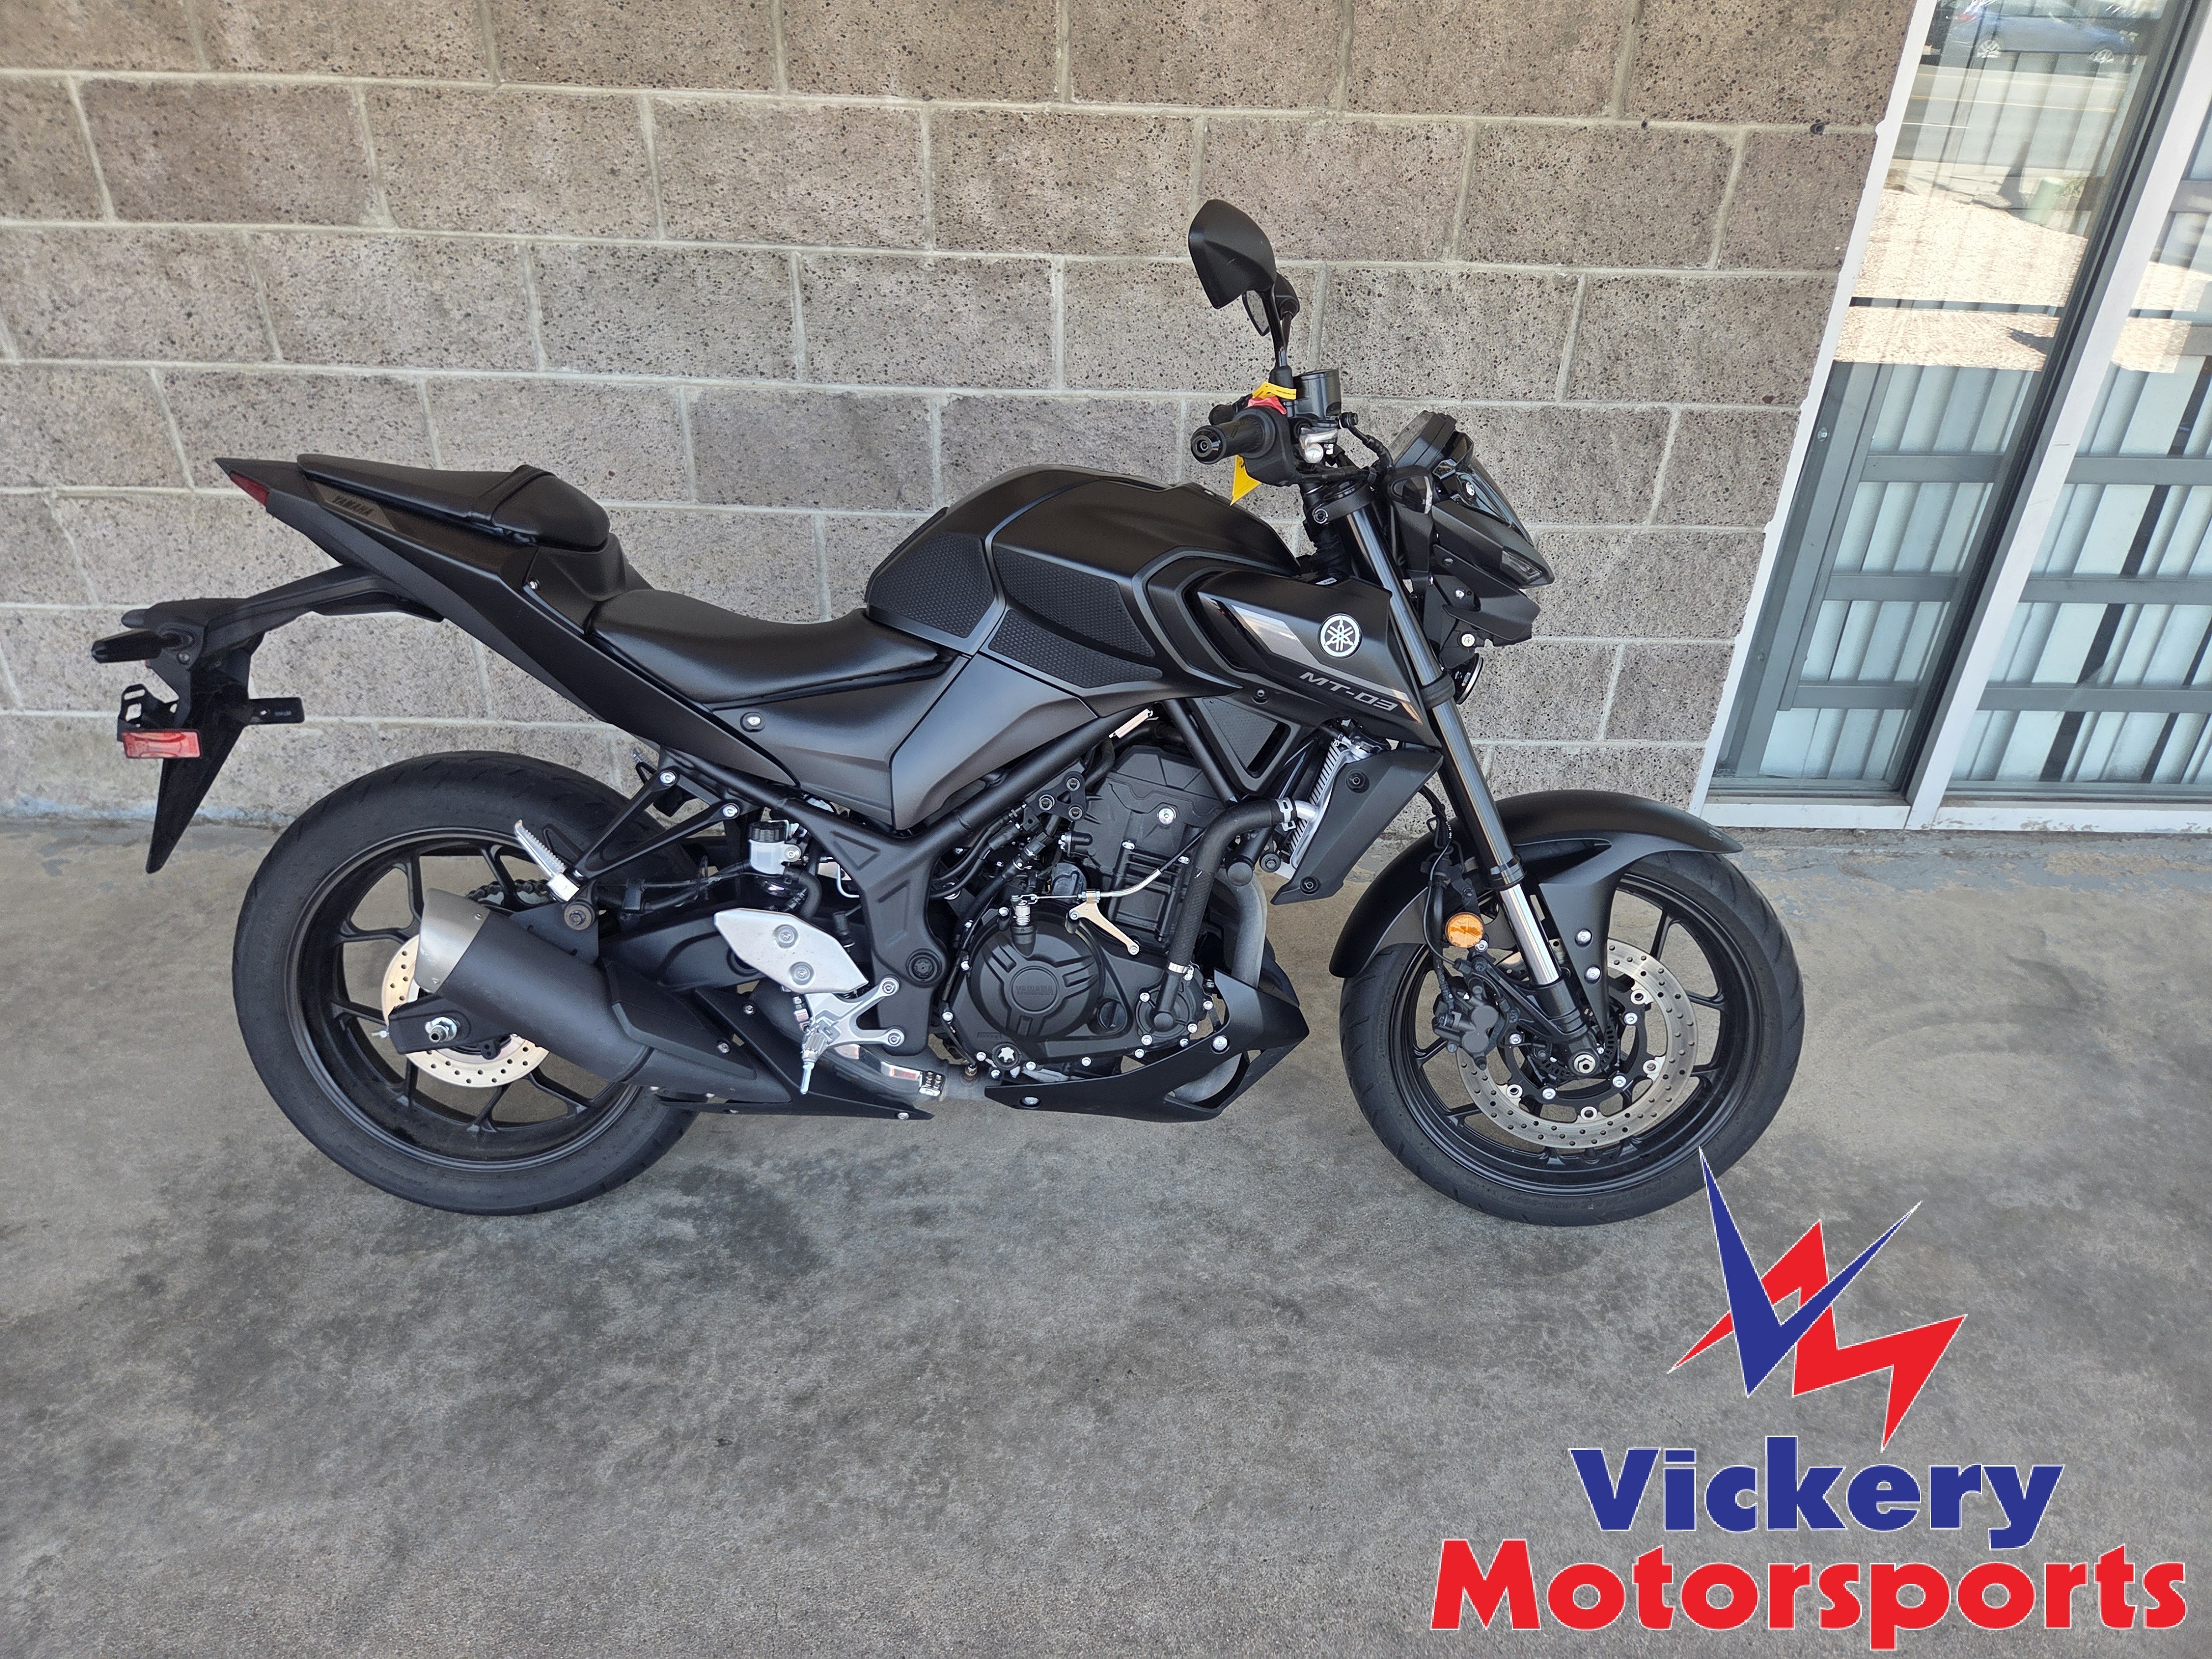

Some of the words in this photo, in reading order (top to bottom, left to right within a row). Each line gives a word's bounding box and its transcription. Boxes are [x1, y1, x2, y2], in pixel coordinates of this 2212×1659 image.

[332, 494, 374, 517] YAMAHA
[1299, 671, 1399, 711] MT-03
[1015, 985, 1054, 995] YAMAHA
